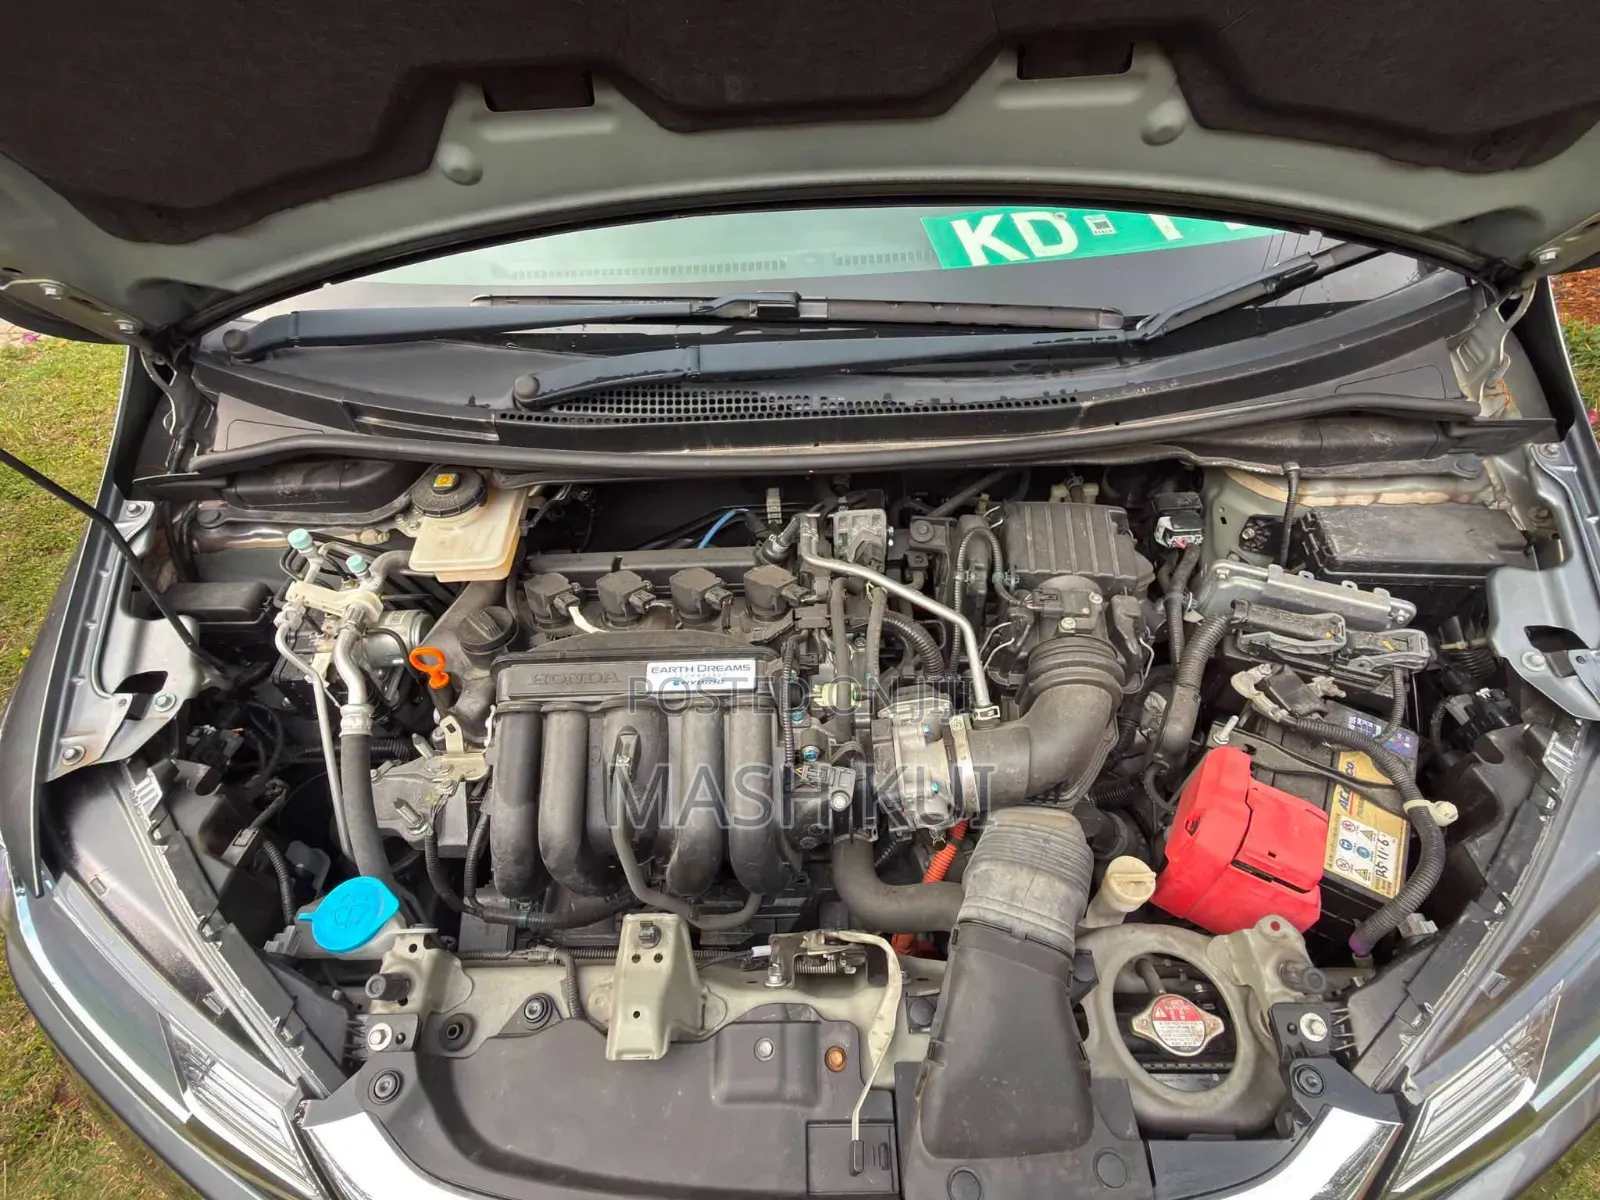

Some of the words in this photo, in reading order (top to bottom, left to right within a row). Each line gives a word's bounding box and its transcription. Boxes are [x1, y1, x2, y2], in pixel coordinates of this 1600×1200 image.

[651, 665, 694, 675] EARTH
[697, 663, 751, 674] DREAMS
[532, 671, 622, 686] HONDA
